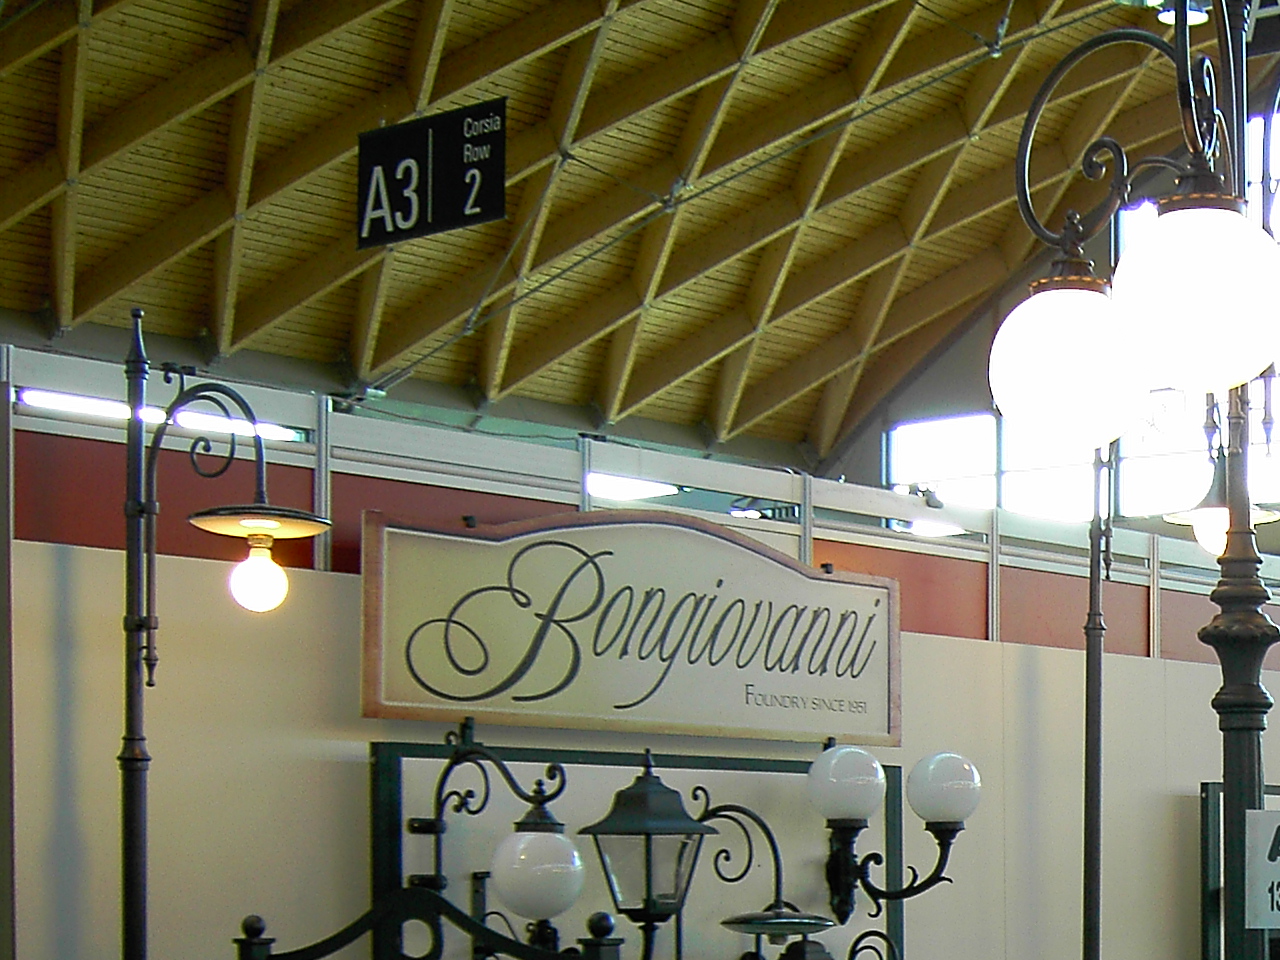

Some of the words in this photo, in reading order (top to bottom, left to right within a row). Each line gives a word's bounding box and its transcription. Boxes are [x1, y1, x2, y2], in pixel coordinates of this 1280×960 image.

[463, 112, 501, 138] Corsia
[463, 143, 491, 163] Row
[361, 158, 419, 238] A3
[464, 168, 482, 215] 2
[405, 540, 881, 709] Bongiovanni
[745, 684, 808, 709] FOUNDRY
